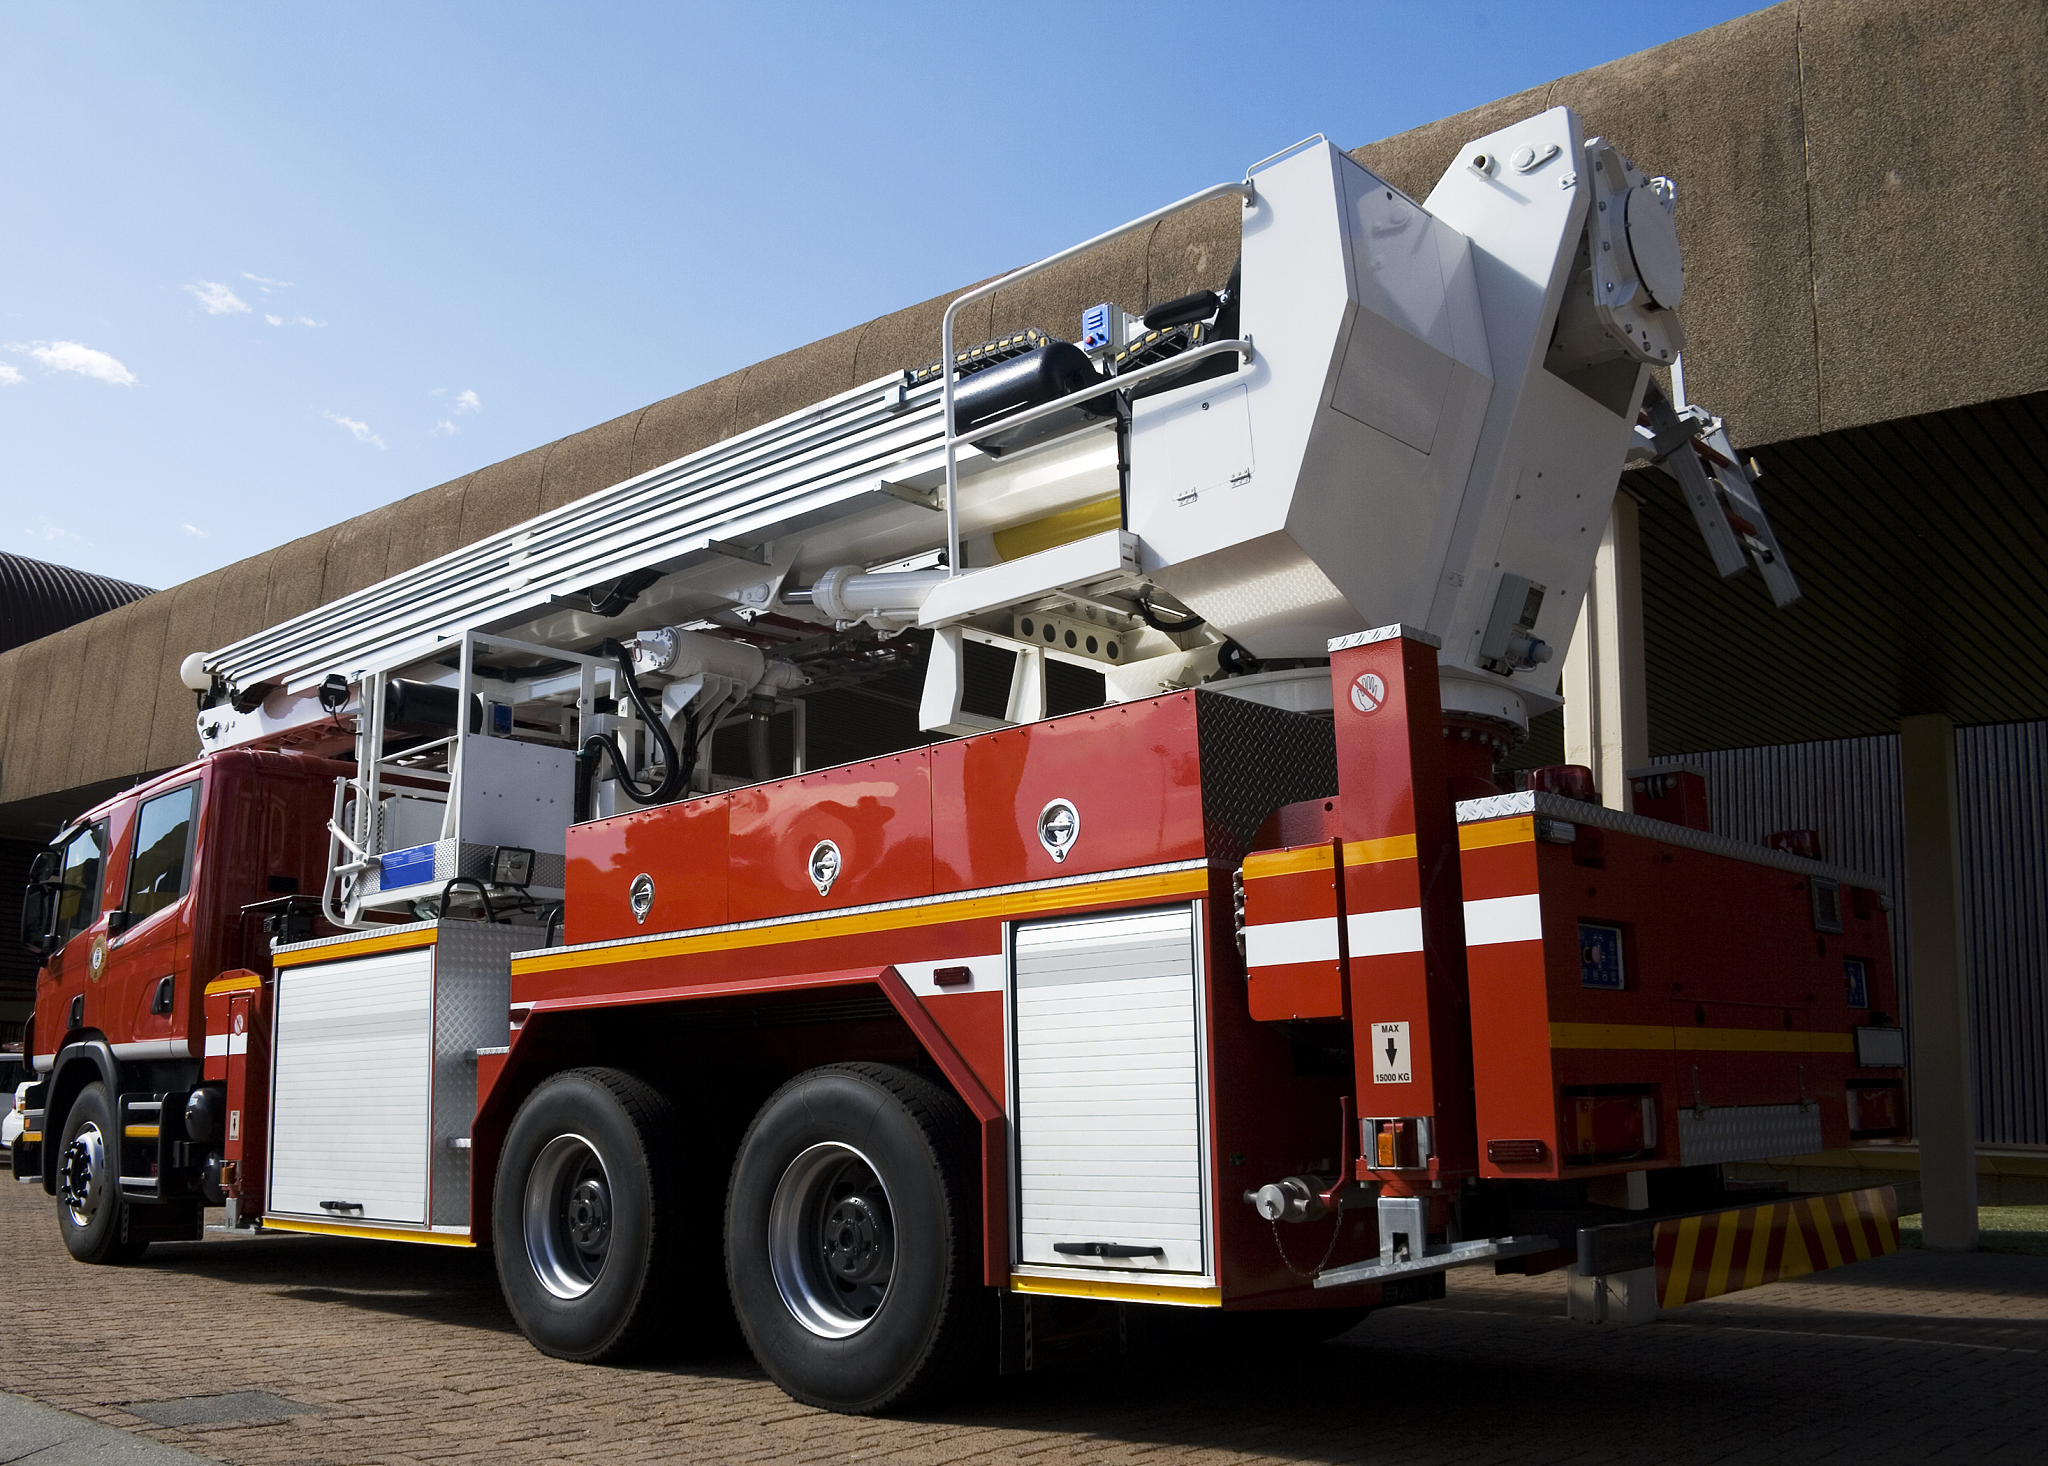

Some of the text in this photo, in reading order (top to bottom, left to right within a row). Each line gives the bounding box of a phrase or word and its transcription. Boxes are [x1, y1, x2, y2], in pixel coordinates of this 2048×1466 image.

[1381, 1024, 1399, 1033] MAX
[1376, 1072, 1410, 1082] 15000 KG
